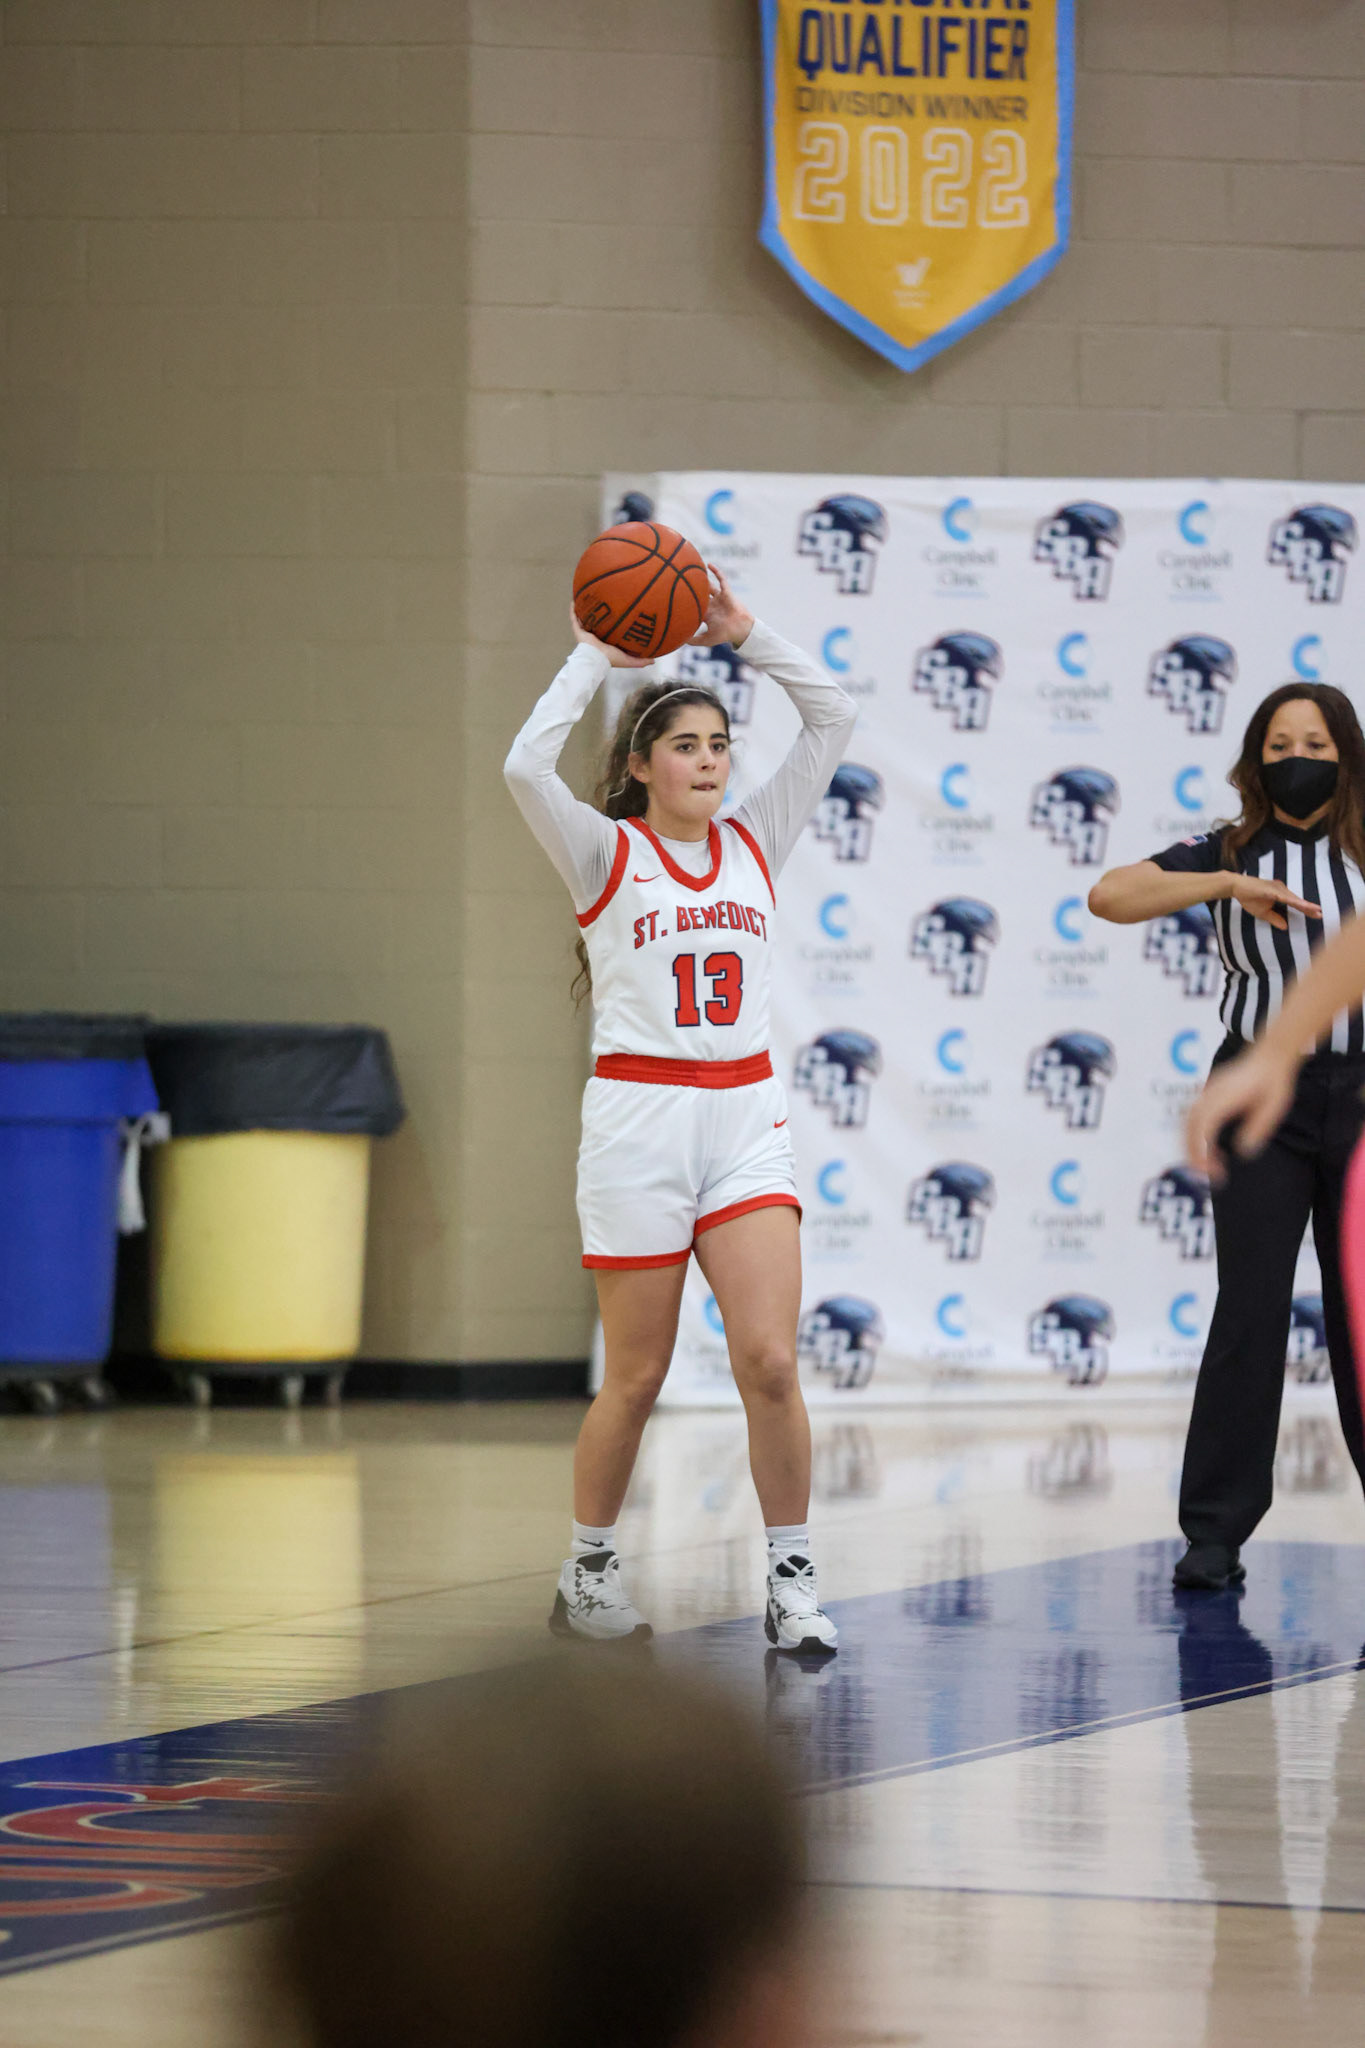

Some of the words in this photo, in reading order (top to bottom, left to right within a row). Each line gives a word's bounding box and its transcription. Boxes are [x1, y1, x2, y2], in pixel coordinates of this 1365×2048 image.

[797, 9, 1029, 81] QUALIFIER
[796, 86, 915, 118] DIVISION
[923, 95, 1029, 122] WINNER
[794, 121, 1030, 229] 2022
[634, 910, 668, 950] ST.
[676, 900, 767, 942] BENEDICT
[672, 951, 744, 1027] 13
